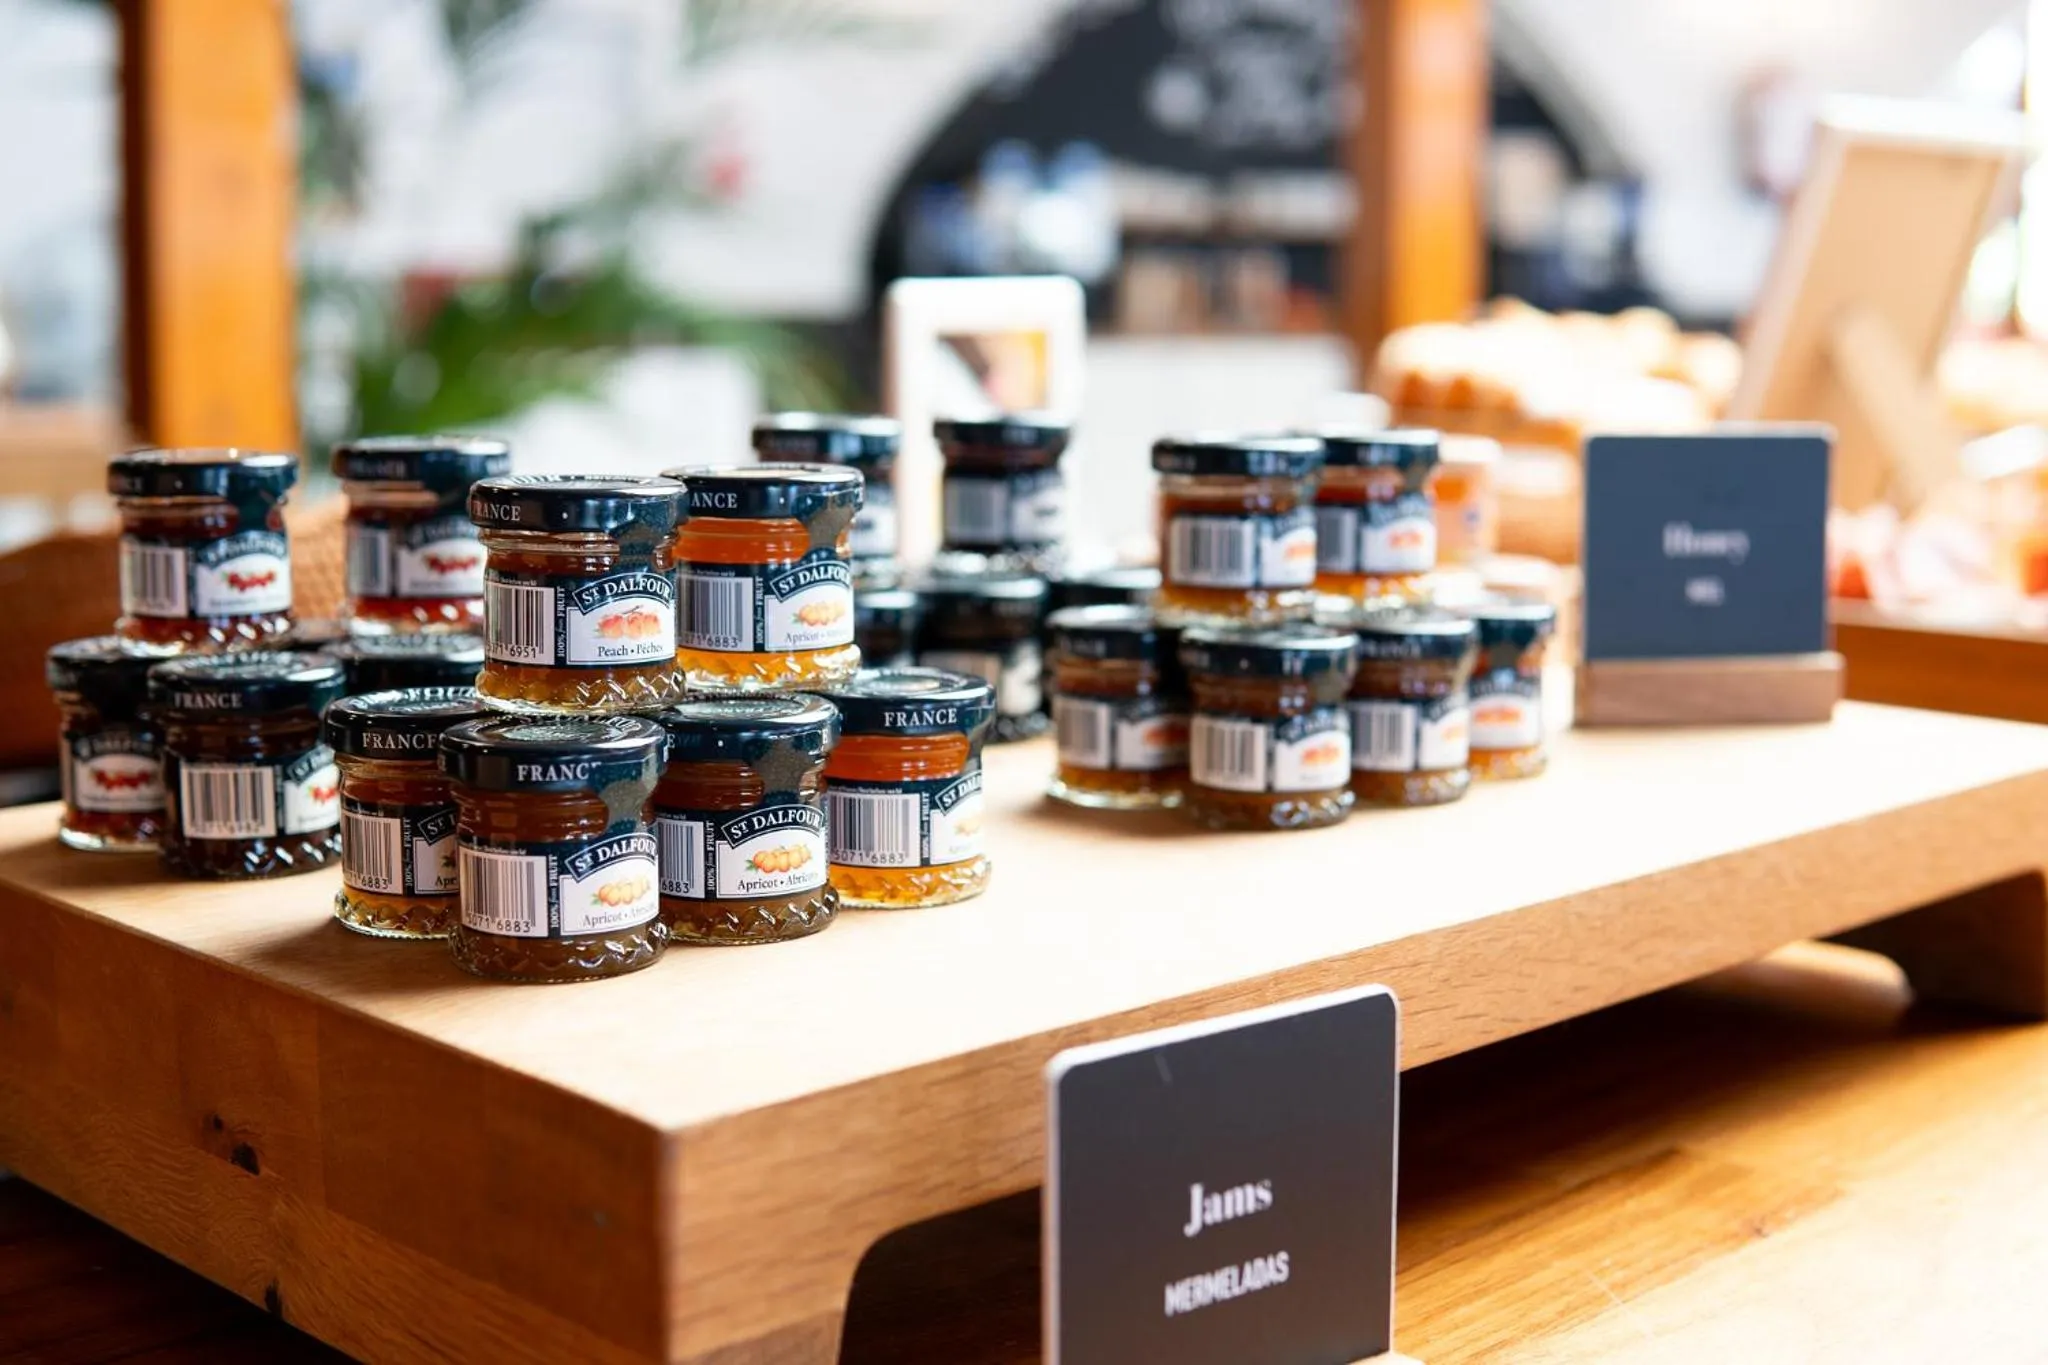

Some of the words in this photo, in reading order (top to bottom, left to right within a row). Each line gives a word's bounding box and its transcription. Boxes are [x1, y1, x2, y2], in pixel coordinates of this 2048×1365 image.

[605, 577, 671, 598] DALFOUR
[556, 586, 566, 617] FRUIT
[509, 645, 537, 659] 6951
[597, 645, 629, 657] Peach
[174, 691, 243, 709] FRANCE
[884, 708, 958, 728] FRANCE
[516, 761, 602, 782] FRANC
[753, 809, 822, 828] DALFOUR
[738, 877, 779, 891] Apricot
[496, 917, 532, 933] 6883
[582, 911, 624, 928] Apricot
[1184, 1178, 1273, 1237] Jams
[1165, 1250, 1290, 1316] MERMELADAS
